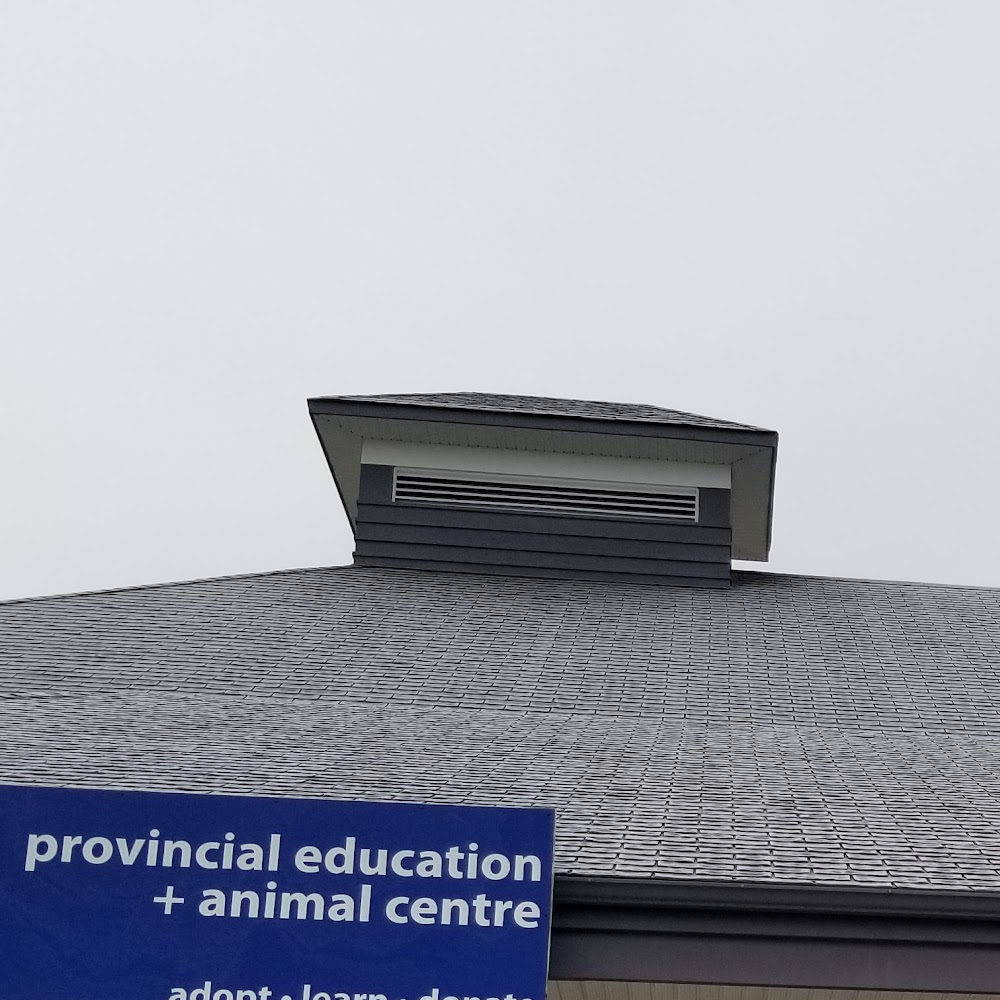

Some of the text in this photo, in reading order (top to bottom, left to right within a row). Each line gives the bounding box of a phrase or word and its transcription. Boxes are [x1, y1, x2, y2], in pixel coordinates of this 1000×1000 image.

[25, 829, 541, 881] provincial education
[199, 881, 371, 922] animal
[386, 894, 540, 928] centre
